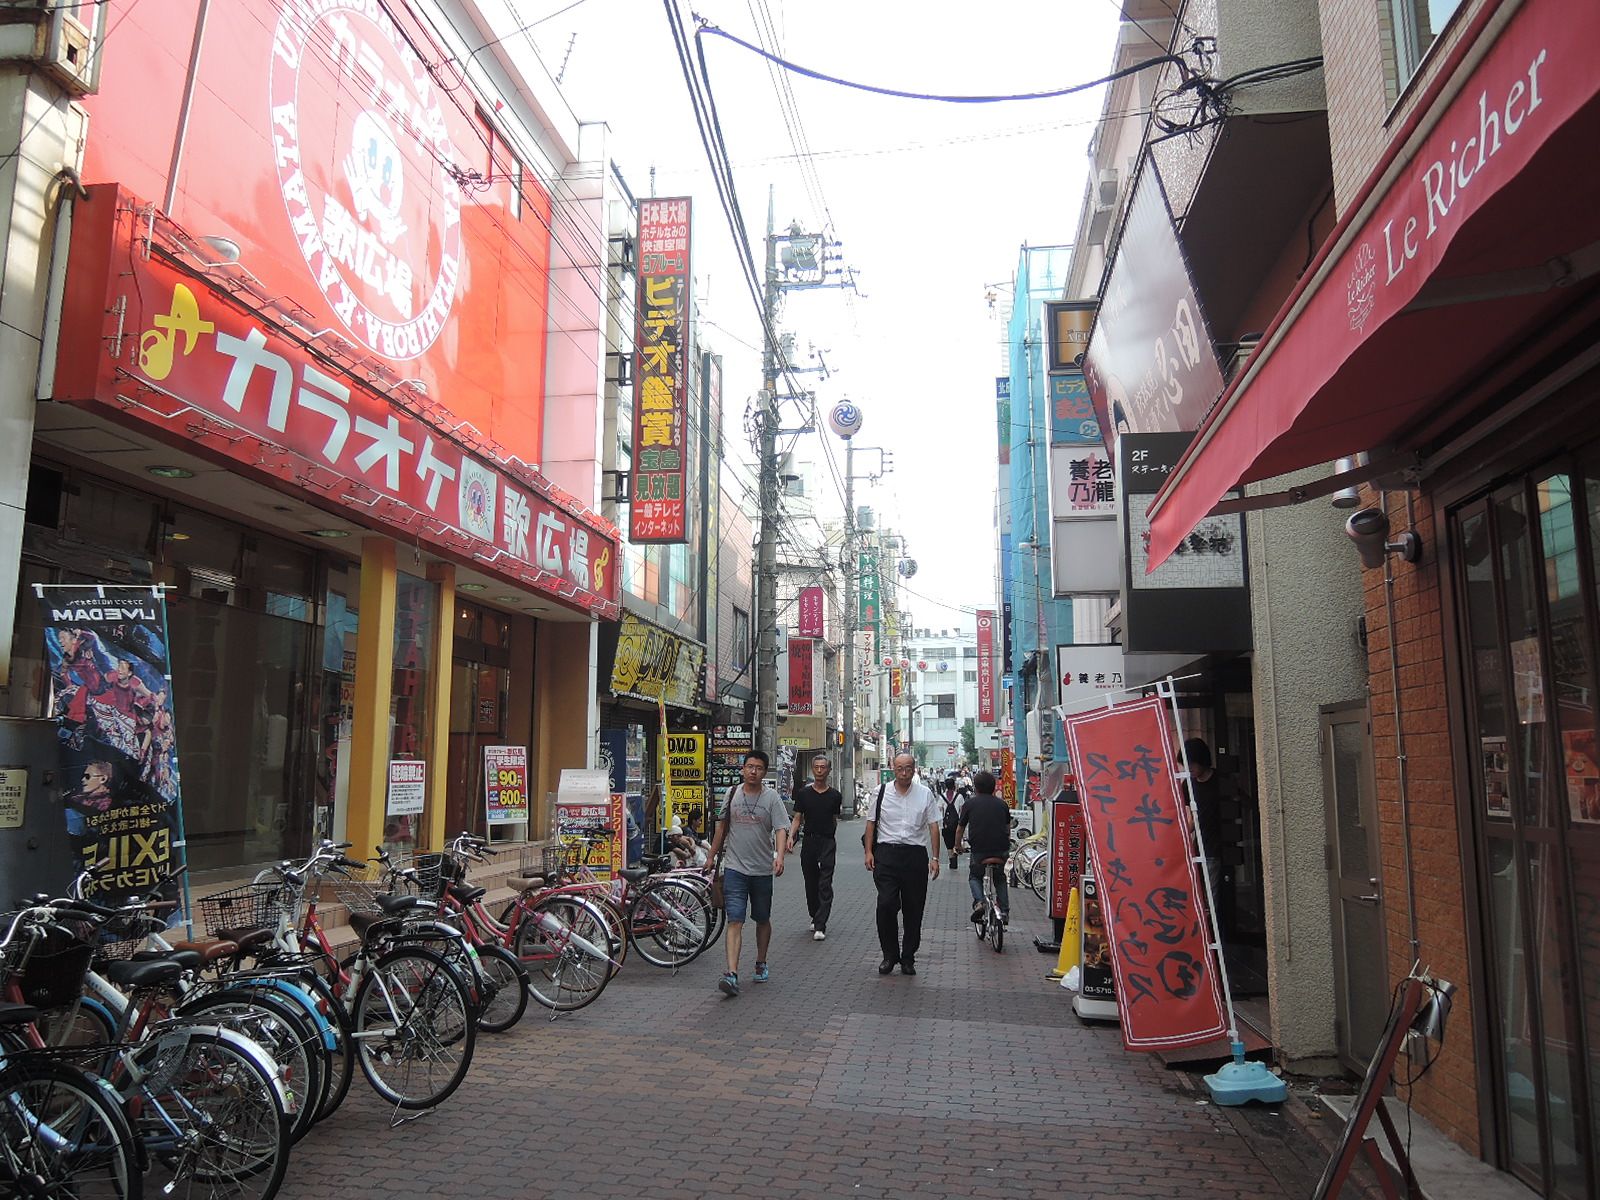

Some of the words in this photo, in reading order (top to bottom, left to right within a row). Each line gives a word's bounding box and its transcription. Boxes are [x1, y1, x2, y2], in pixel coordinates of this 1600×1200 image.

[1383, 218, 1419, 286] Le
[1421, 48, 1547, 240] Richer
[271, 101, 359, 328] KAMATA
[641, 225, 687, 239] ホテルなみの
[322, 193, 413, 320] 歌広場
[641, 239, 687, 252] 快適空間
[363, 253, 459, 358] UTAHIROBA
[640, 277, 676, 447] ビデオ鑑賞
[216, 326, 457, 513] カラオケ
[638, 449, 681, 471] 宝島
[1131, 450, 1149, 462] 2F
[1069, 459, 1113, 481] 養老
[635, 473, 682, 502] 見放題
[1069, 480, 1115, 502] 乃瀧
[634, 503, 681, 518] 一般テレビ
[503, 484, 590, 592] 歌広場
[634, 520, 681, 536] インターネット
[1078, 672, 1123, 684] 養老乃
